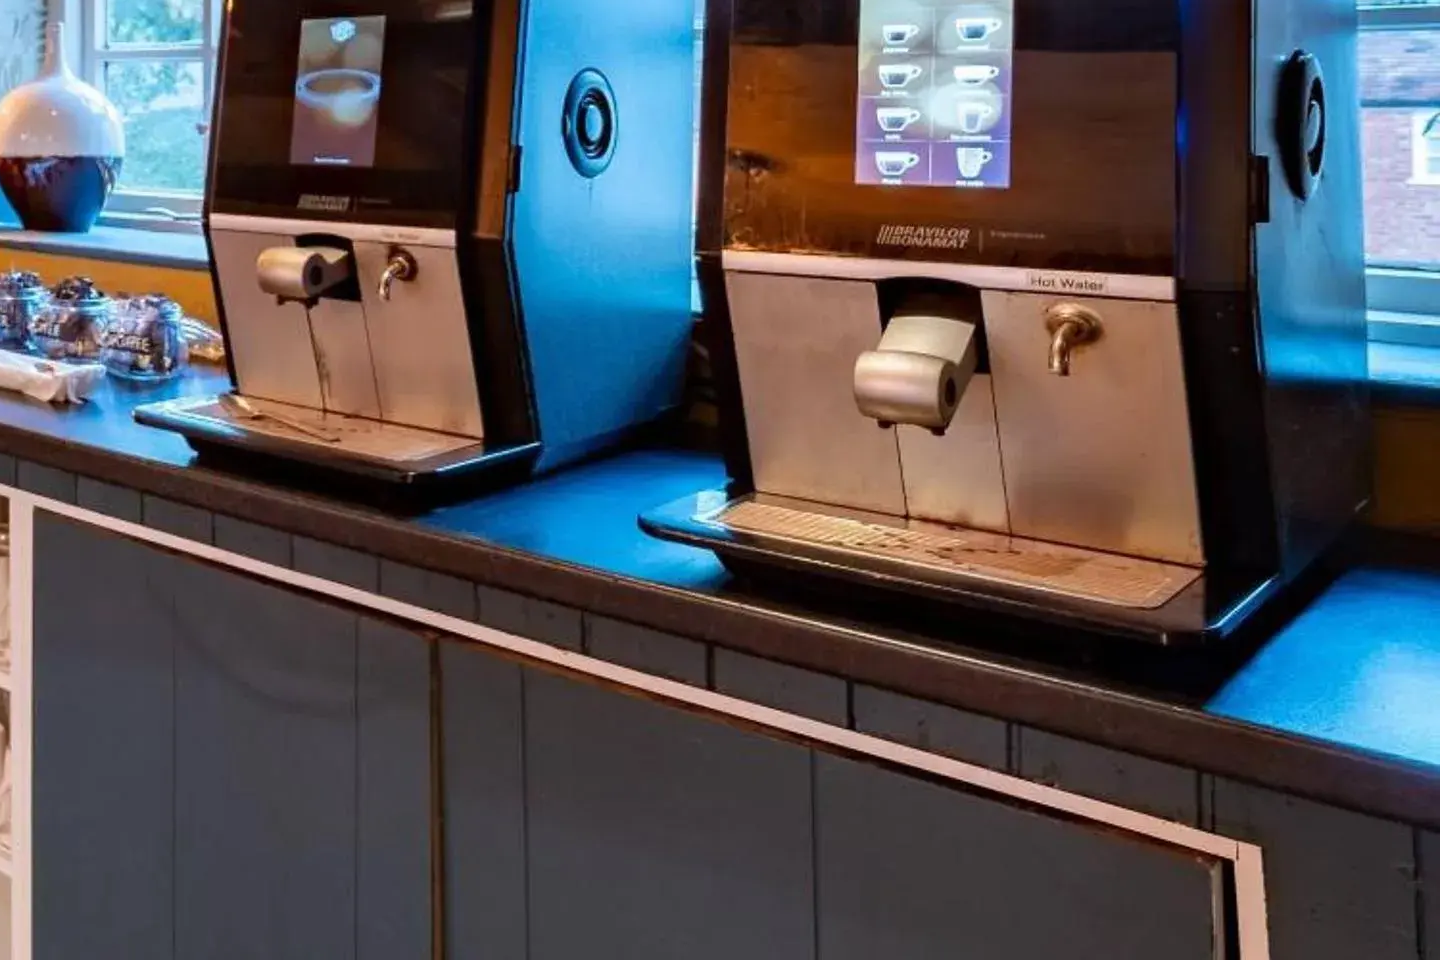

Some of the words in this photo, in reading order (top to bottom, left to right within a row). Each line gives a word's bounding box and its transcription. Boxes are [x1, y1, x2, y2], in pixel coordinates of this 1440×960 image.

[893, 225, 971, 239] BRAVILOR
[891, 236, 968, 248] BONAMAT
[1031, 276, 1056, 288] Hot
[1061, 278, 1104, 290] Water
